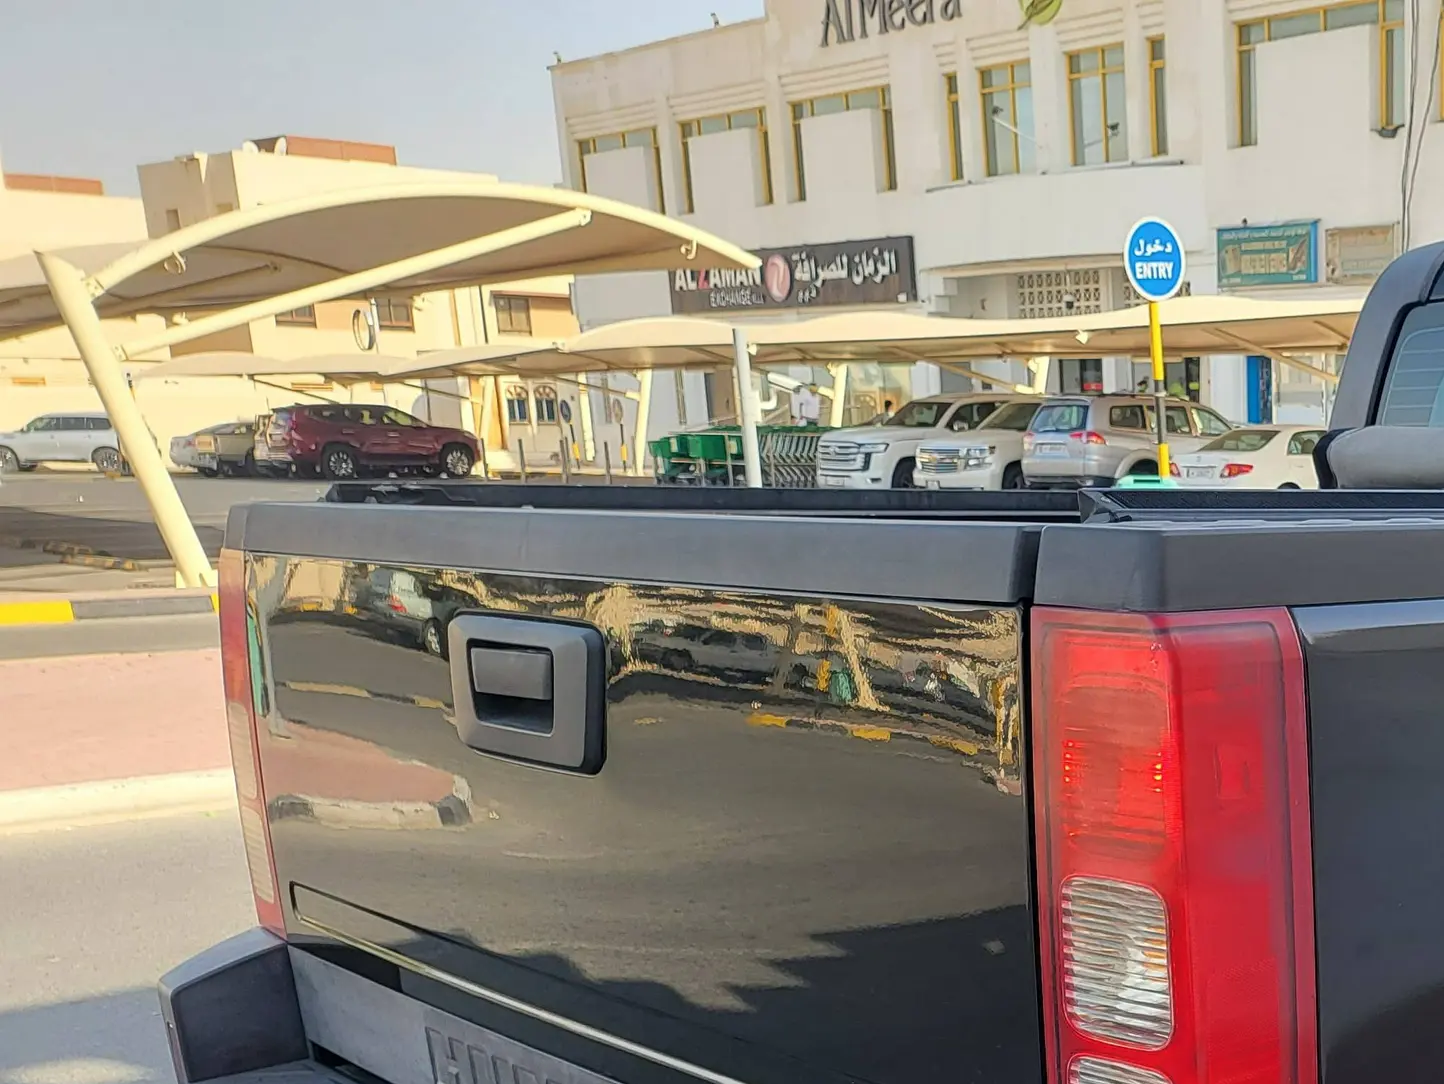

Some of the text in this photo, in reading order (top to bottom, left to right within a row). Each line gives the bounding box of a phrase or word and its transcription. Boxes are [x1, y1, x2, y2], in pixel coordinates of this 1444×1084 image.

[1134, 238, 1172, 256] دخول
[791, 247, 896, 288] الزمان للصرافة
[1135, 261, 1173, 279] ENTRY
[710, 287, 752, 308] EXCHANGE
